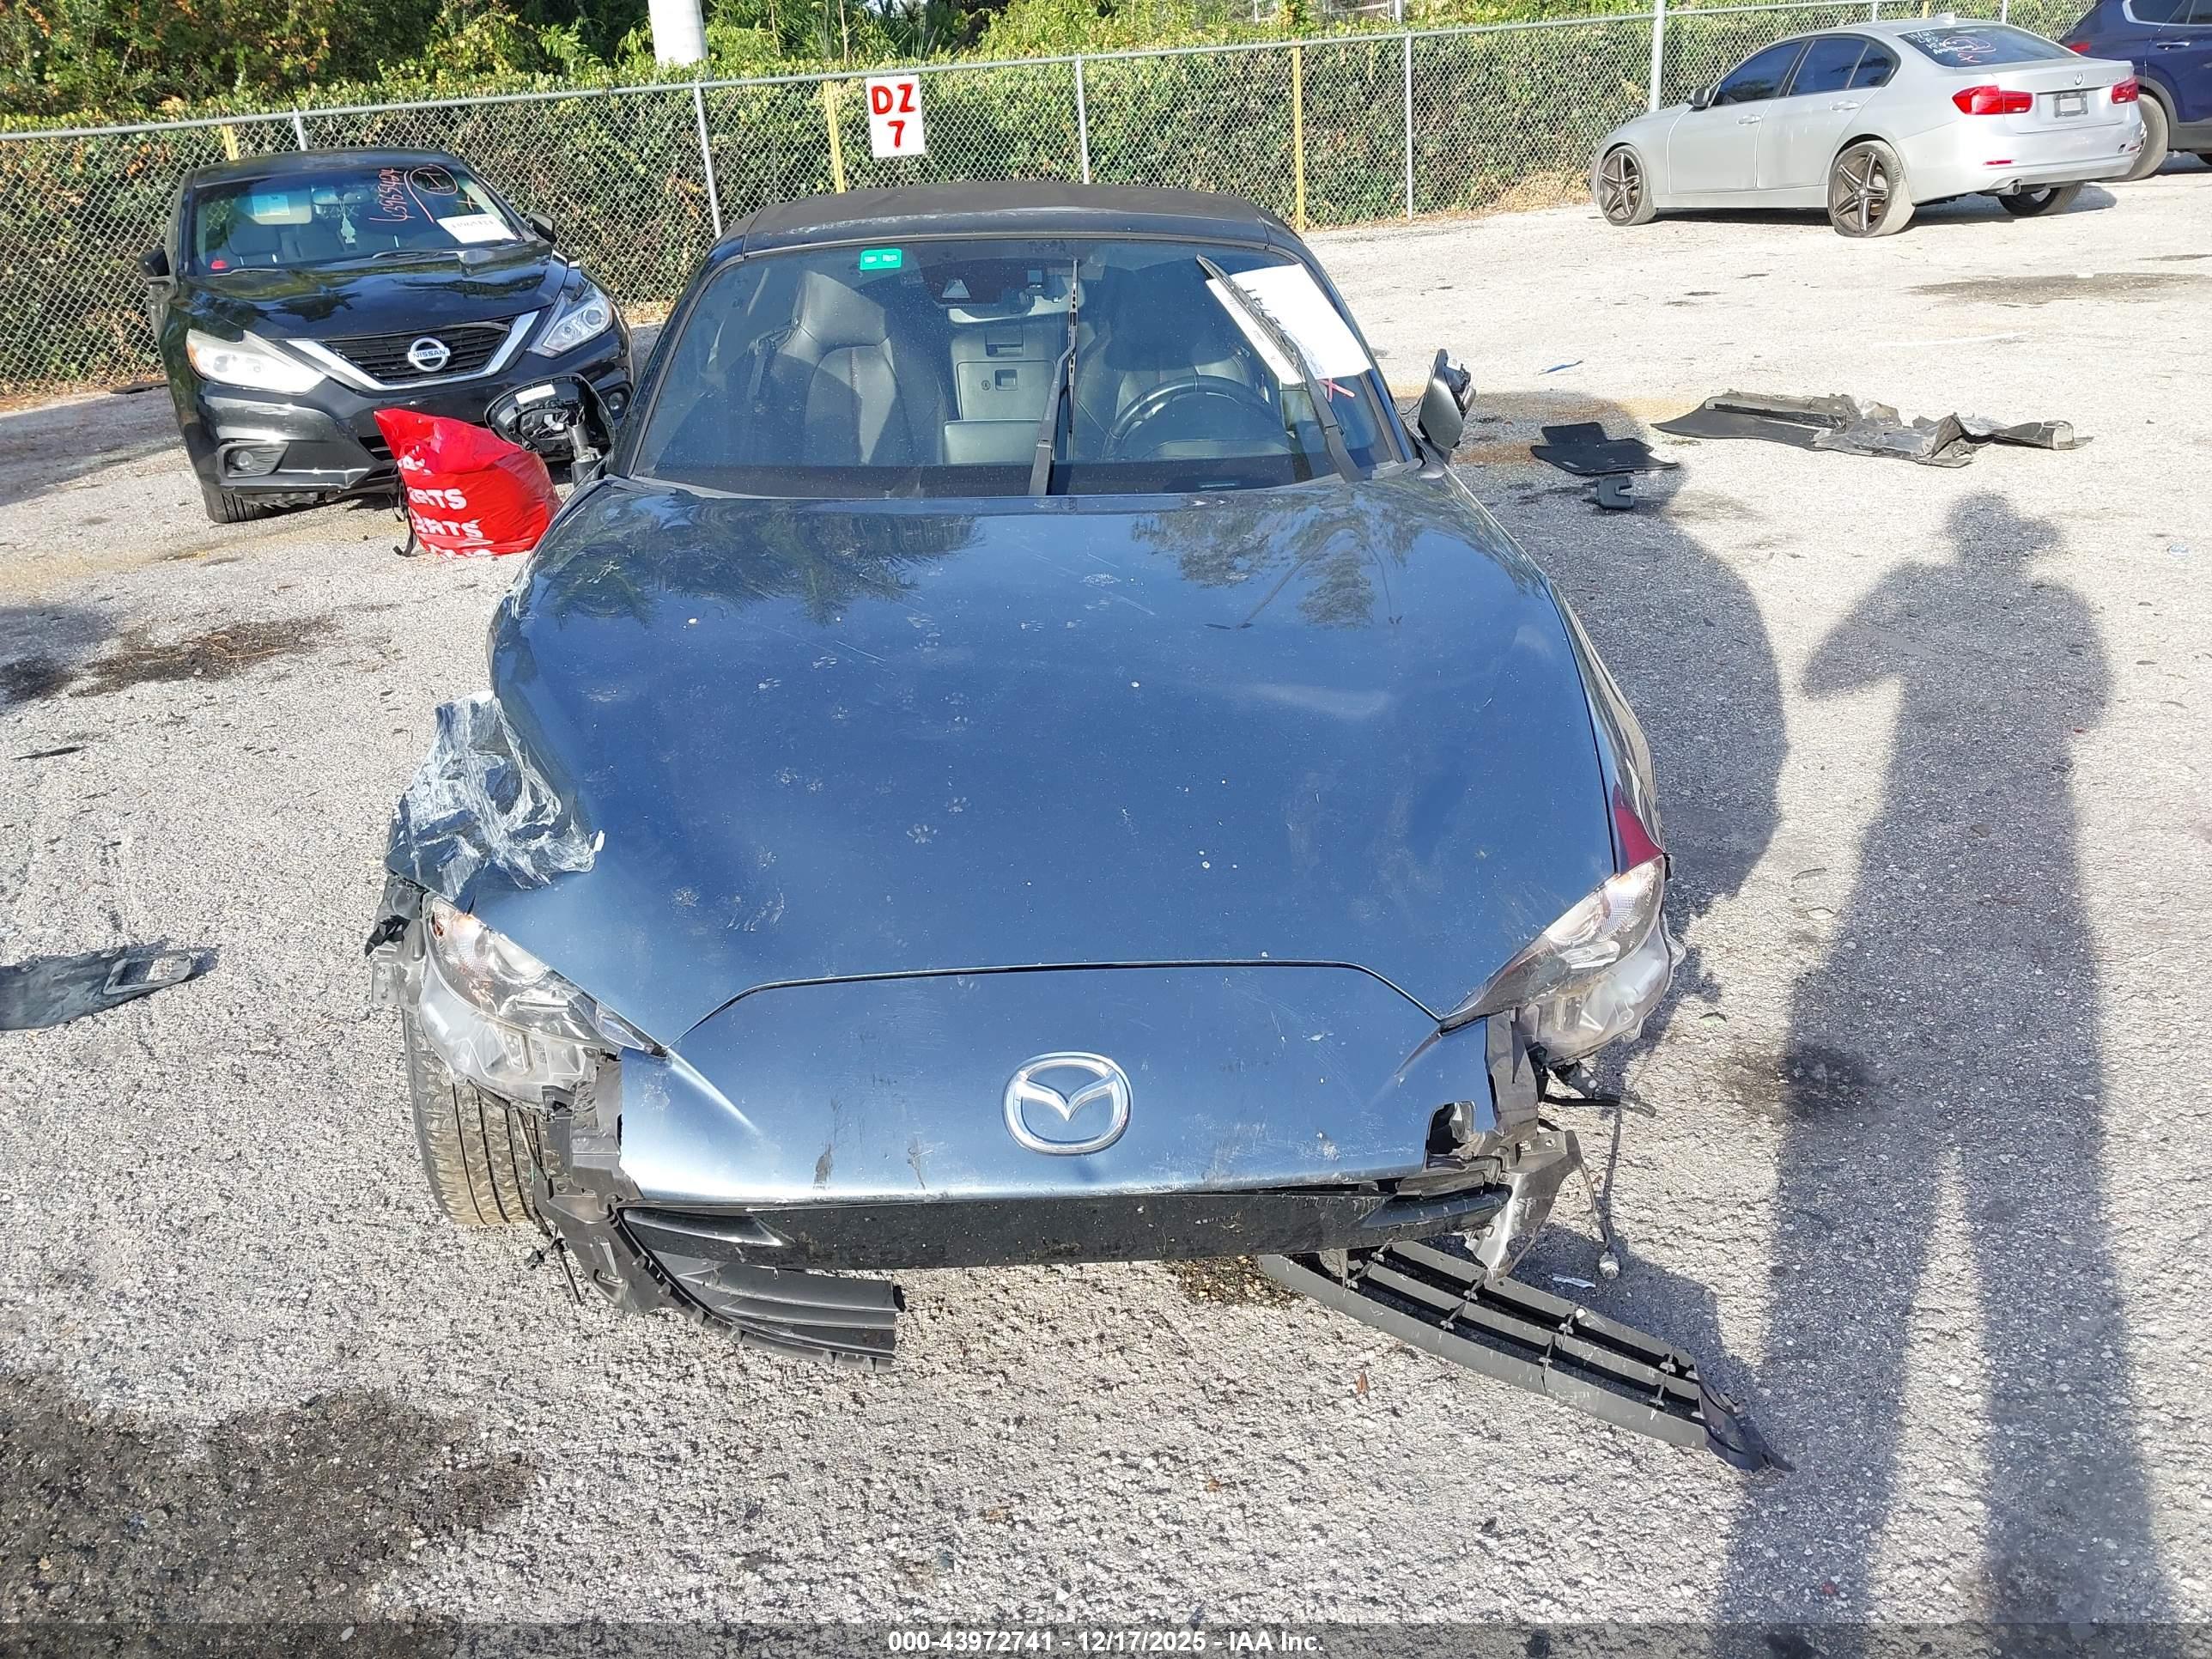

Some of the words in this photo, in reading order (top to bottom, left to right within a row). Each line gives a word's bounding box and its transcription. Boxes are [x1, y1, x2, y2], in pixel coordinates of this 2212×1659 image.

[871, 83, 915, 114] DZ
[887, 119, 906, 148] 7
[412, 349, 447, 358] NISSAN
